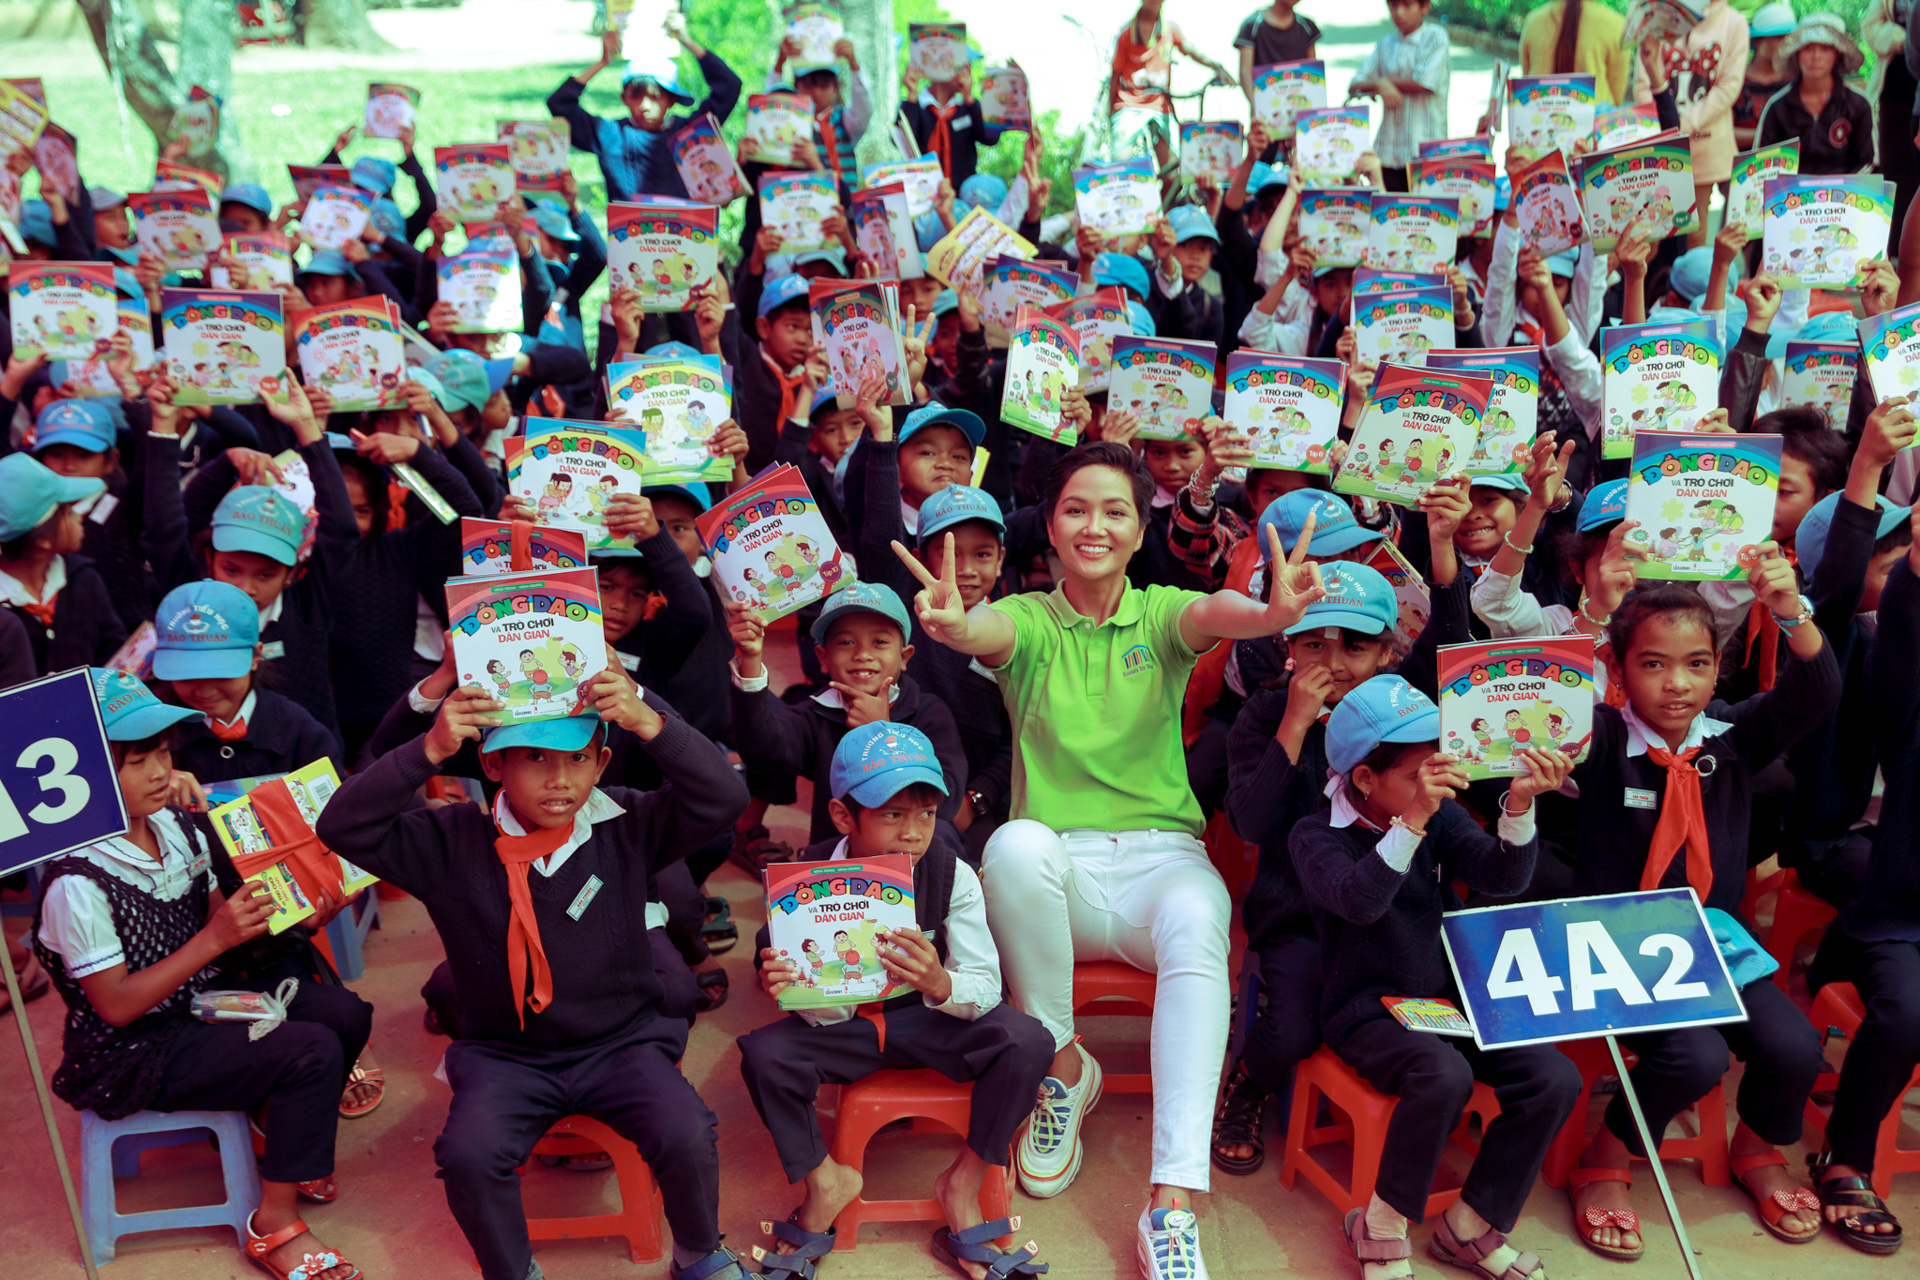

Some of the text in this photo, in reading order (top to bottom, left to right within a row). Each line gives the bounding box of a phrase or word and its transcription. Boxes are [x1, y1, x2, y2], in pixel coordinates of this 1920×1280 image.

[1831, 190, 1873, 210] DAO
[668, 222, 708, 244] DAO
[1170, 354, 1205, 377] DAO
[1613, 340, 1710, 373] ĐỒNG DAO
[1646, 359, 1685, 371] TRÒ CHƠI
[673, 371, 716, 391] DAO
[1290, 372, 1329, 398] DAO
[1493, 369, 1531, 393] DAO
[1642, 370, 1680, 381] DÂN GIAN
[667, 397, 687, 405] GIAN
[1442, 395, 1483, 427] DAO
[1410, 411, 1453, 425] TRÒ CHƠI
[1422, 423, 1445, 434] GIAN
[532, 436, 634, 469] ĐỒNG DAO
[565, 457, 606, 468] TRÒ CHƠI
[559, 464, 601, 476] DÂN GIAN
[1640, 453, 1767, 485] ĐỒNG DAO
[1676, 487, 1700, 497] DÂN
[1683, 478, 1733, 486] TRÒ CHƠI
[935, 507, 953, 518] BẢO
[1601, 504, 1622, 514] BẢO
[713, 498, 804, 553] ĐỒNG DAO
[744, 518, 782, 542] TRÒ CHƠI
[744, 528, 783, 552] DÂN GIAN
[530, 544, 575, 567] DAO
[1336, 569, 1366, 597] TIỂU HỌC
[1325, 596, 1364, 607] THUẬN
[459, 596, 588, 636] ĐỒNG DAO
[502, 618, 554, 632] TRÒ CHƠI
[168, 632, 228, 643] BẢO THUẬN
[498, 630, 550, 643] DÂN GIAN
[1451, 660, 1581, 695] ĐỒNG DAO
[1493, 682, 1515, 693] TRÒ
[1519, 682, 1545, 691] CHƠI
[106, 692, 133, 713] BẢO
[1391, 681, 1403, 708] TRƯỜNG
[1487, 692, 1539, 703] DÂN GIAN
[1397, 702, 1418, 717] BẢO
[861, 732, 884, 760] TRƯỜNG
[863, 754, 926, 772] BẢO THUẬN
[778, 878, 902, 915] ĐỒNG DAO
[819, 901, 840, 913] TRÒ
[844, 901, 869, 910] CHƠI
[815, 912, 864, 923] DÂN GIAN
[1486, 920, 1711, 1017] 4A2
